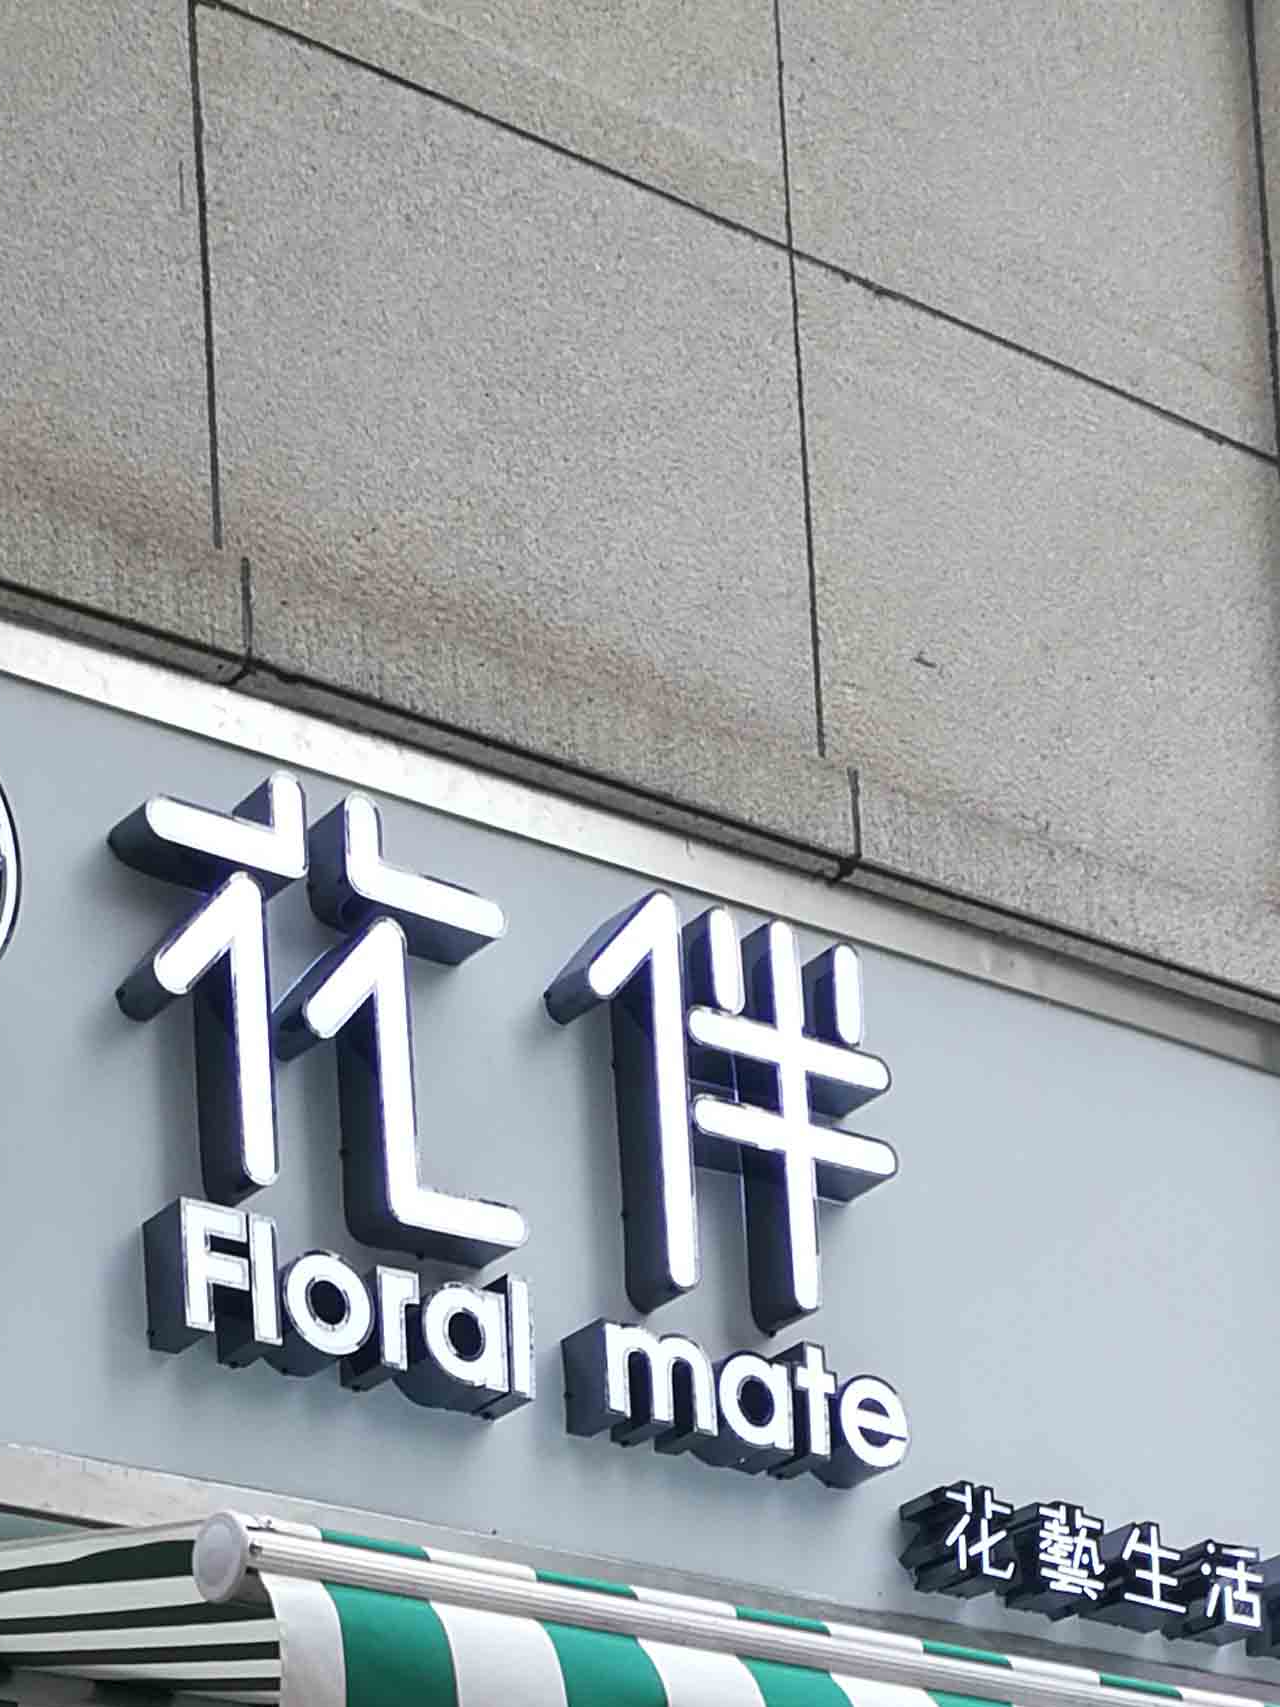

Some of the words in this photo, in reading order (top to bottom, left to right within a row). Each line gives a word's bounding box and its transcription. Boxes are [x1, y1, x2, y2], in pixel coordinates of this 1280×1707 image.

[144, 769, 902, 1314] 花伴
[180, 1197, 535, 1402] Floral
[605, 1322, 912, 1469] mate
